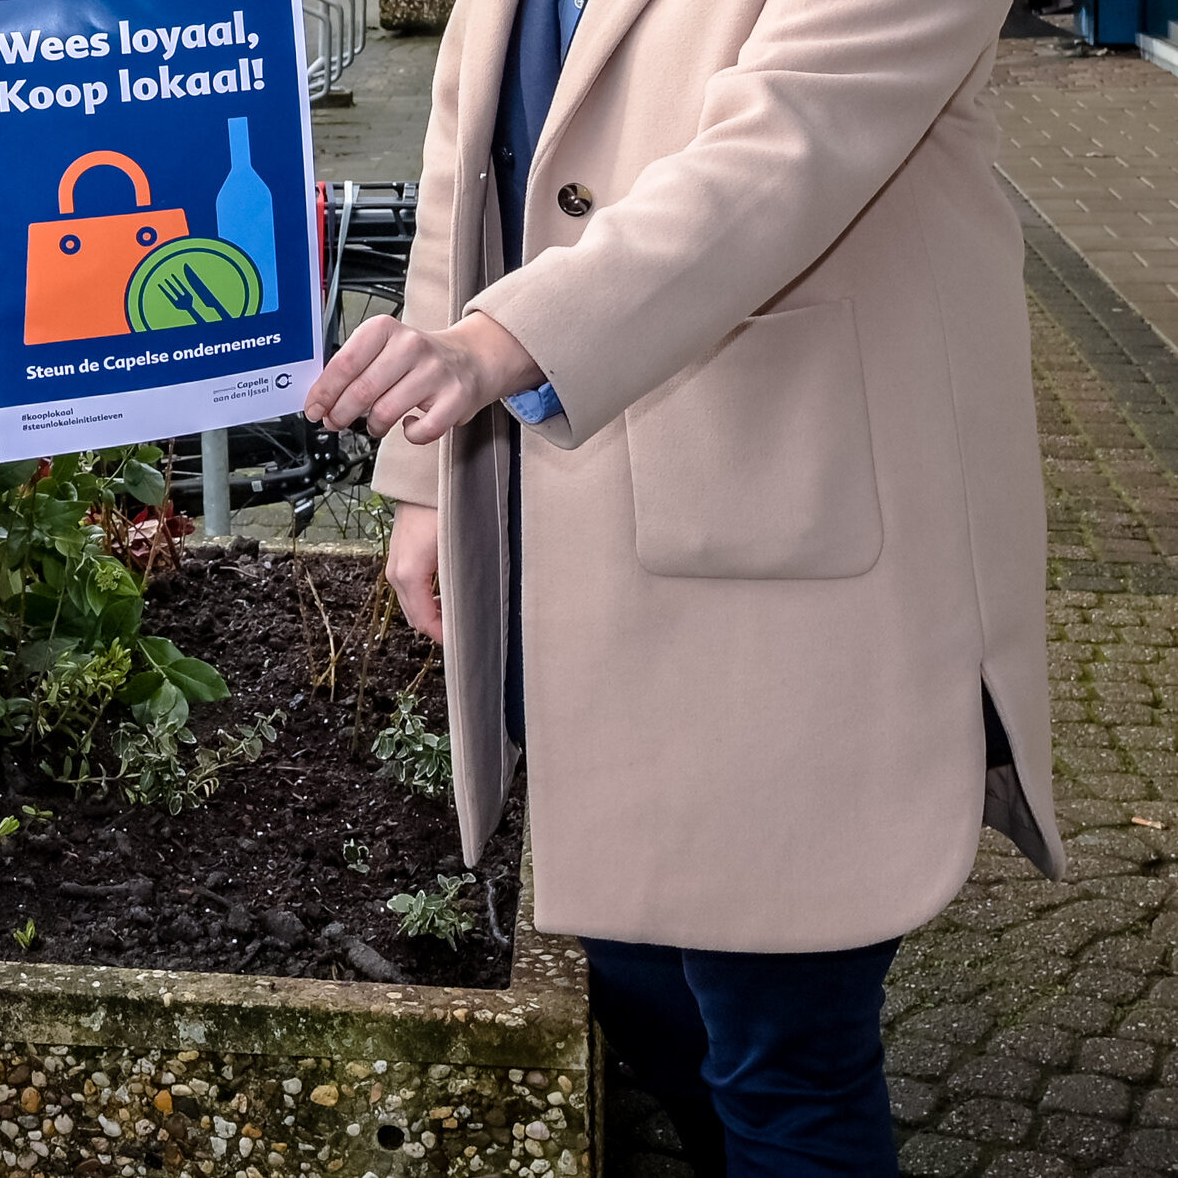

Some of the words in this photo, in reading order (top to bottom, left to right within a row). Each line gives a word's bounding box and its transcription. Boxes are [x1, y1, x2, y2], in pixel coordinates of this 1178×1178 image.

[118, 10, 260, 61] loyaal,
[118, 57, 265, 103] lokaal!
[26, 364, 75, 380] Steun
[78, 358, 100, 373] de
[103, 350, 169, 372] Capelse
[172, 332, 282, 361] ondernemers
[237, 377, 269, 390] Capelle
[213, 395, 230, 403] aan
[230, 391, 247, 399] den
[21, 407, 74, 421] #kooplokaal
[22, 413, 124, 431] #steunlokaleinitiatieven
